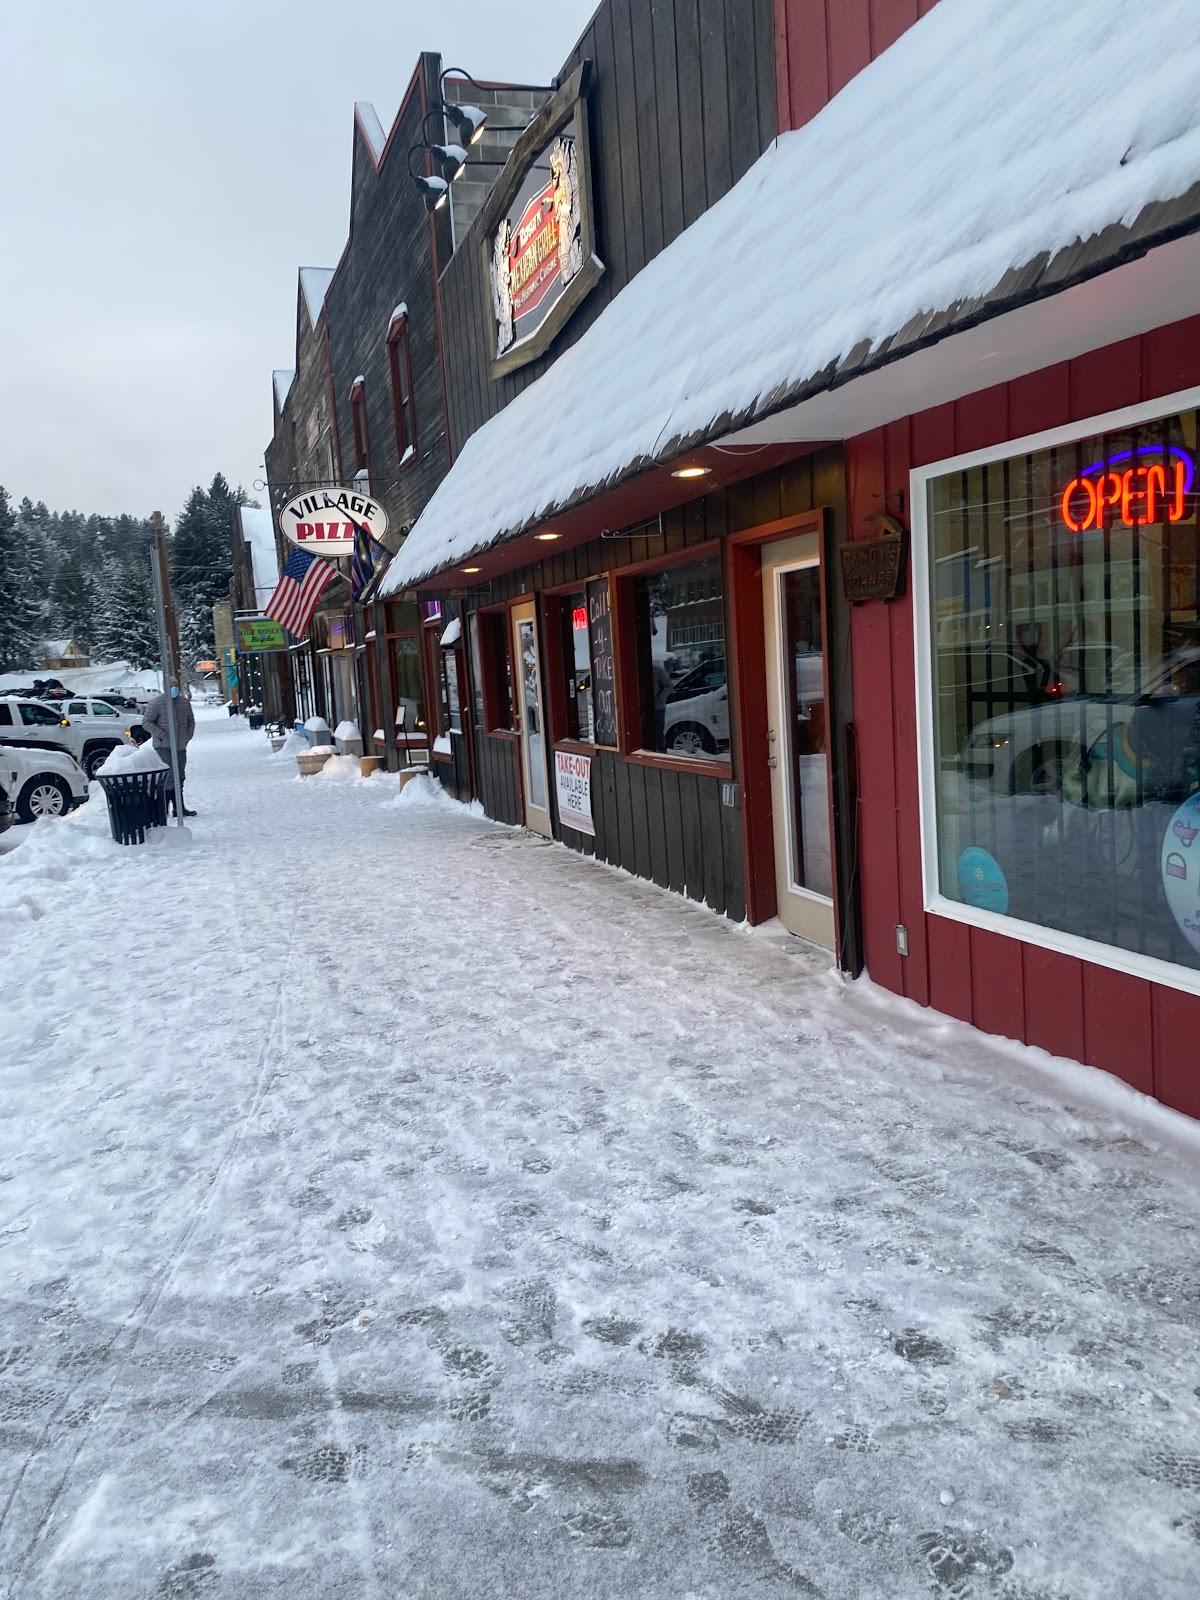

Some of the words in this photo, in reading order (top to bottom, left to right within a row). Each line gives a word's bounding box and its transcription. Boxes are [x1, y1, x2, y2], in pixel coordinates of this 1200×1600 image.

[289, 492, 378, 521] VILLAGE
[1062, 460, 1184, 533] OPEN
[594, 656, 613, 681] TAKE
[598, 689, 613, 715] OUT
[557, 753, 590, 779] TAKE-OUT
[560, 775, 588, 797] AVAILABLE
[567, 793, 582, 811] HERE
